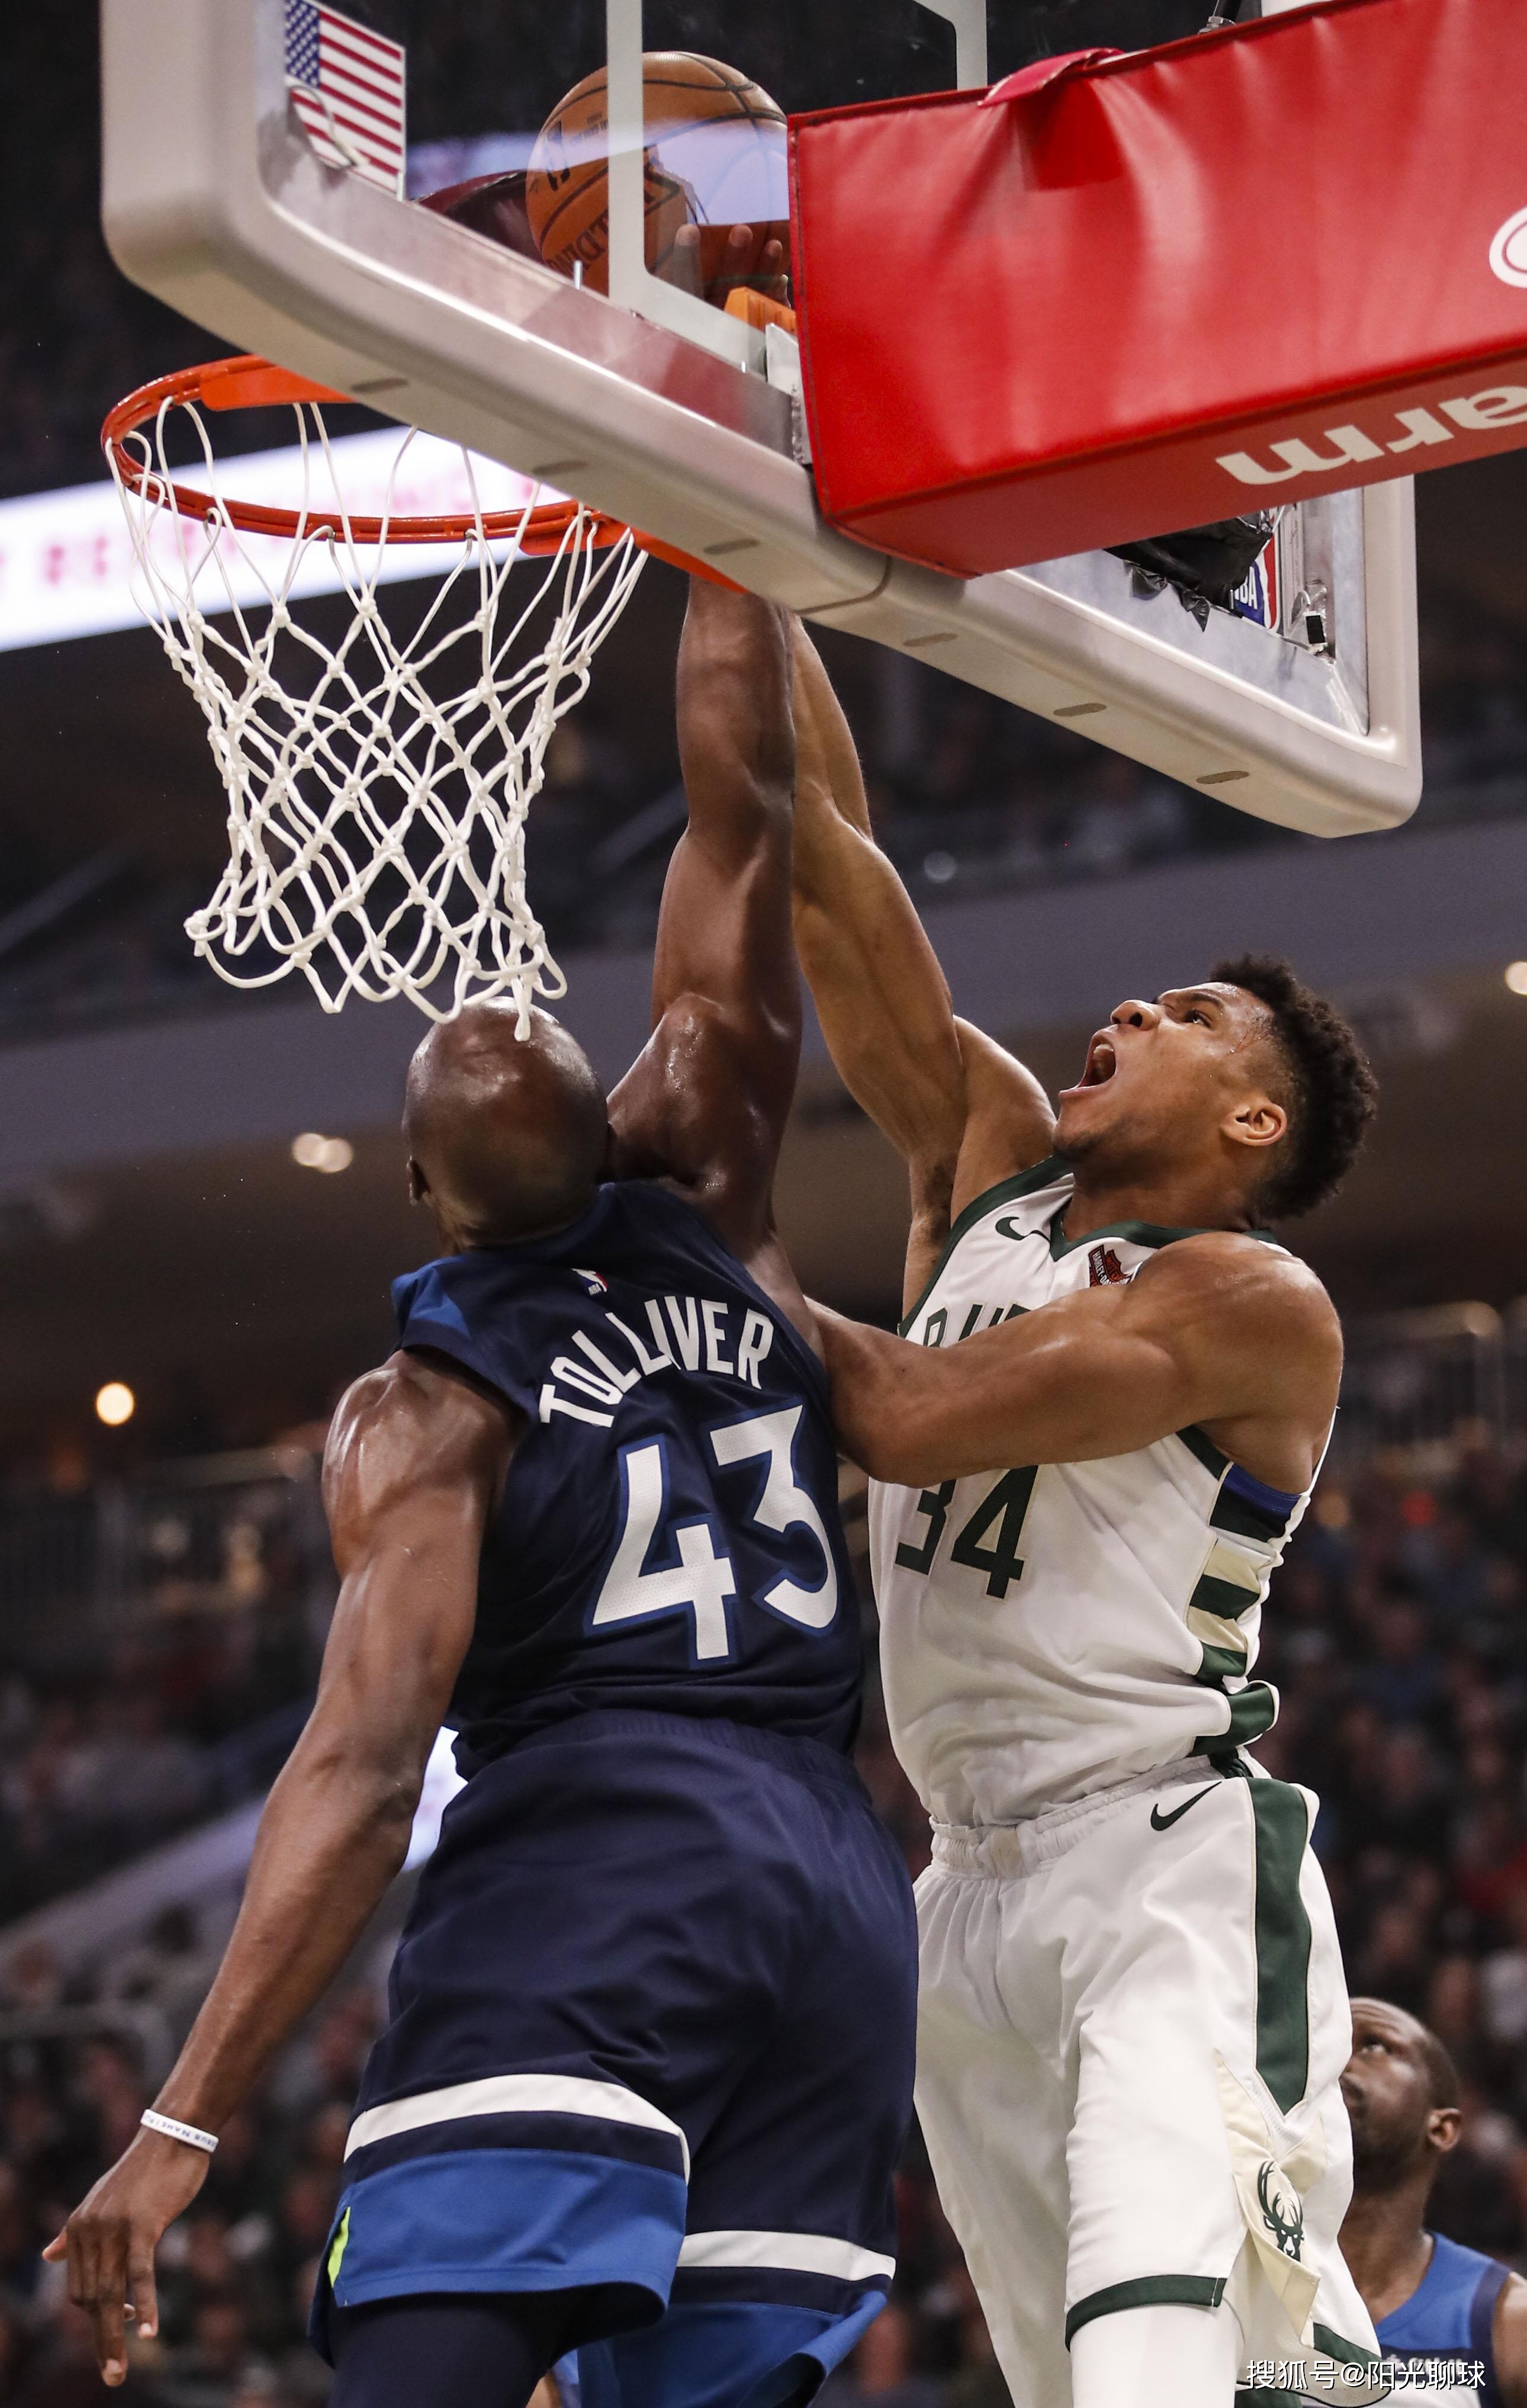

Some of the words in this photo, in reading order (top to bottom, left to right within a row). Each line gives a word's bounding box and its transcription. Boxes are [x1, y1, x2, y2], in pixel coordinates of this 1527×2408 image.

[588, 1283, 602, 1296] NBA
[539, 1296, 774, 1428] TOLLIVER
[591, 1404, 838, 1661] 43
[895, 1465, 1039, 1600] 34
